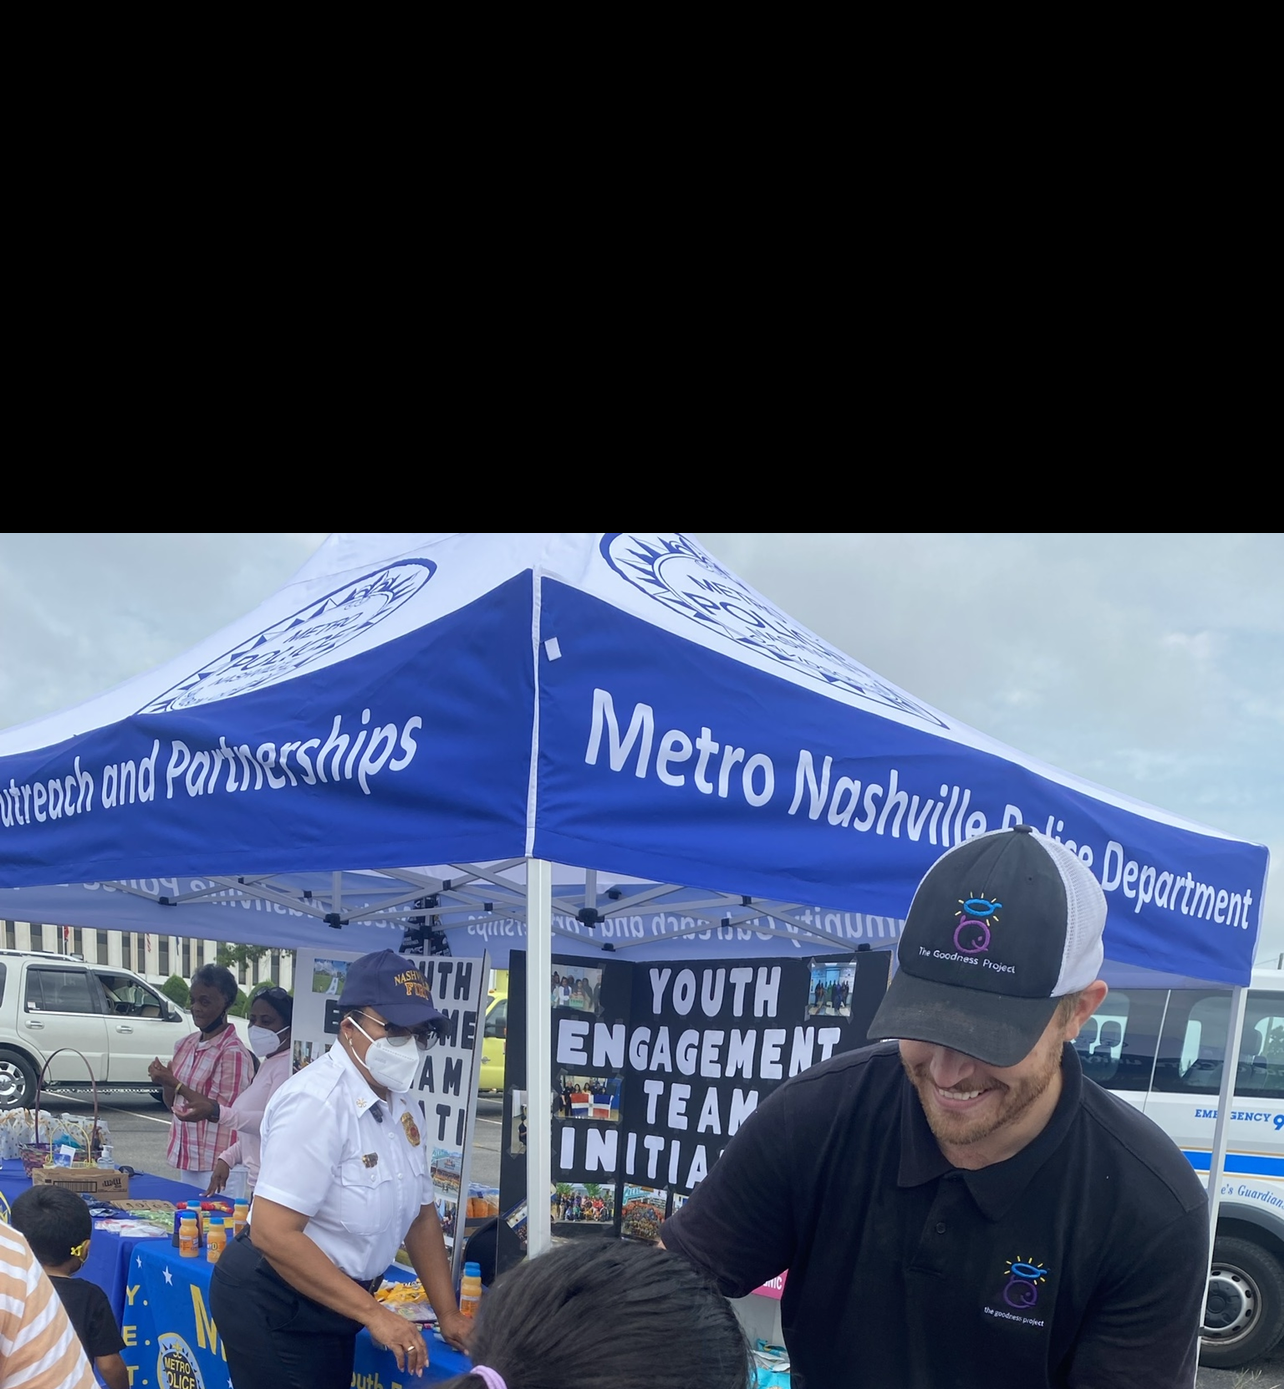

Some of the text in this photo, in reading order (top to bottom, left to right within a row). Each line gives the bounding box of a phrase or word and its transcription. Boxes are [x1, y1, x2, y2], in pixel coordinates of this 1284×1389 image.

[216, 624, 358, 676] POLICE
[0, 708, 422, 827] utreach and Partnerships
[585, 688, 775, 806] Metro
[788, 749, 987, 848] Nashville
[1102, 840, 1252, 929] Department
[408, 960, 472, 1001] UTH
[919, 946, 1015, 974] The Goodness Project
[649, 966, 782, 1018] YOUTH
[556, 1018, 841, 1080] ENGAGEMENT
[643, 1079, 759, 1137] TEAM
[559, 1126, 725, 1189] INITIA
[984, 1307, 1044, 1327] the goodness project
[165, 1357, 190, 1374] METRO
